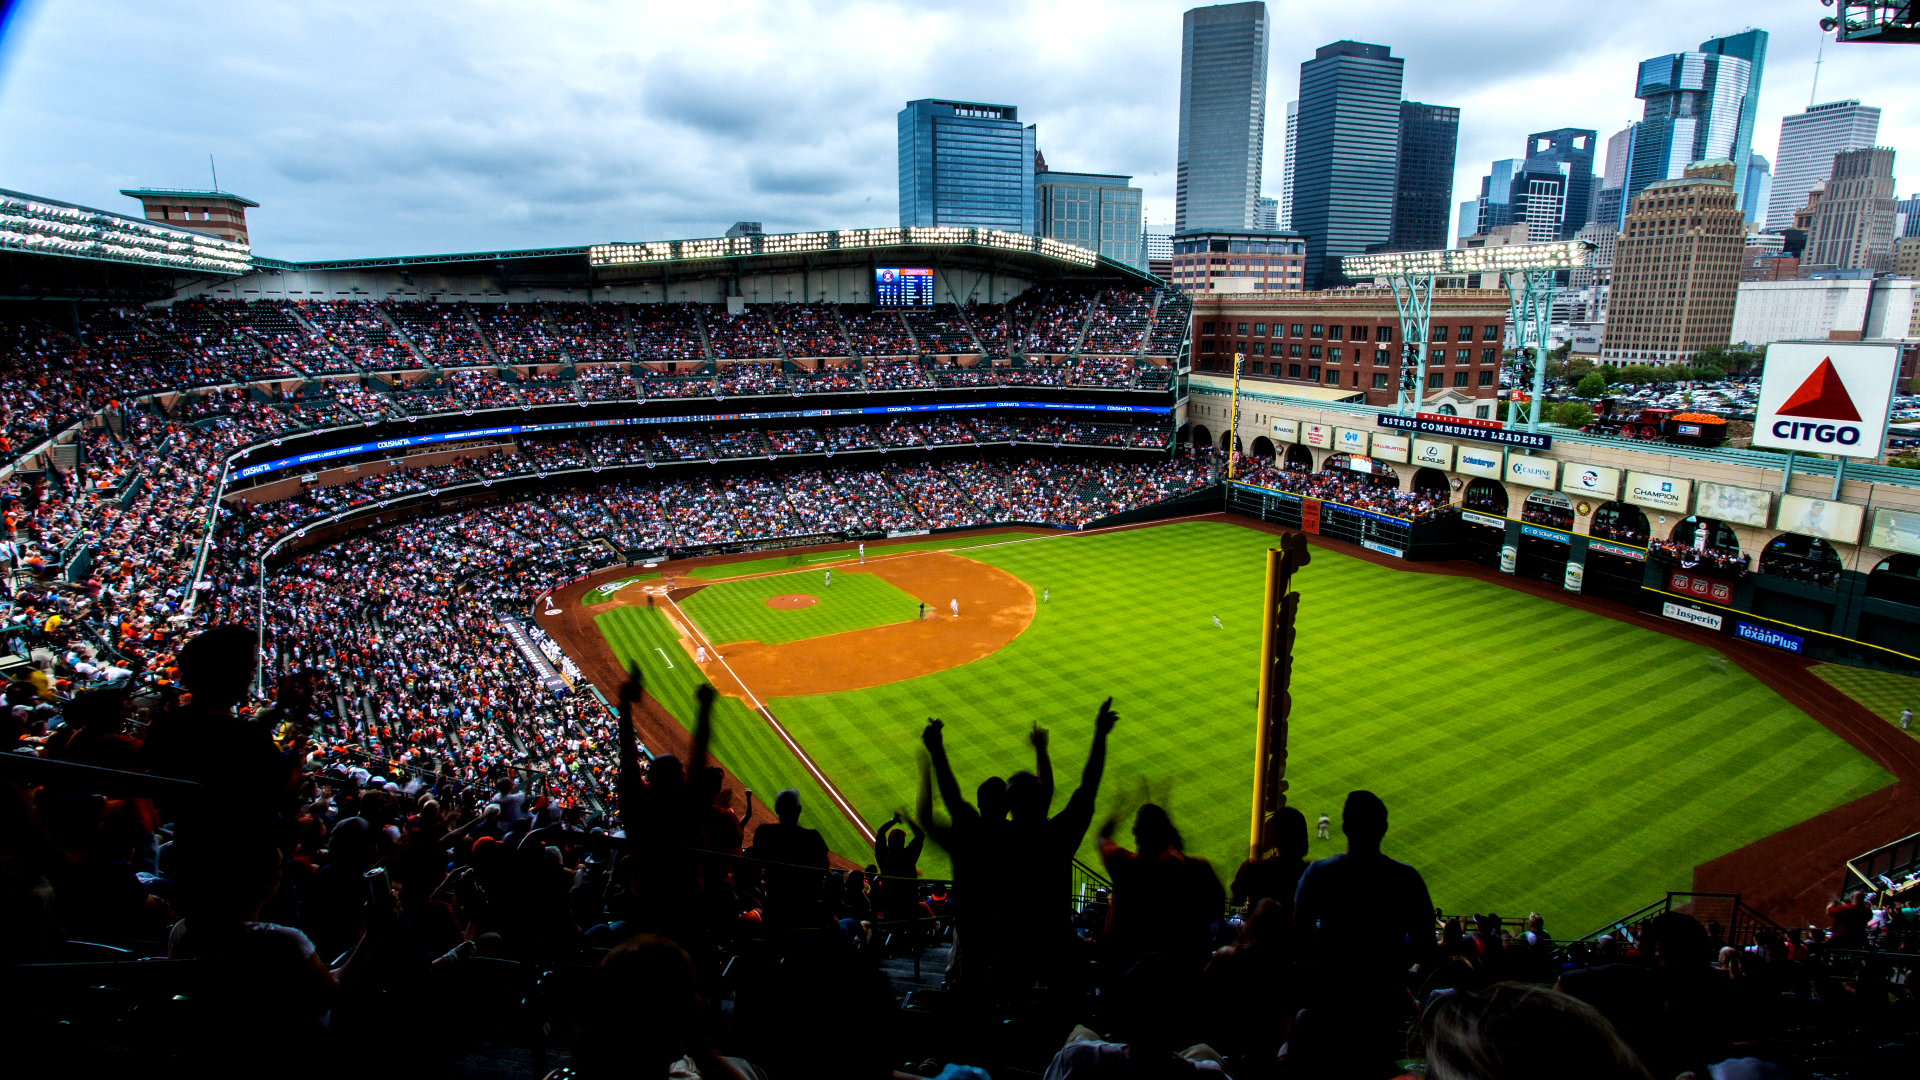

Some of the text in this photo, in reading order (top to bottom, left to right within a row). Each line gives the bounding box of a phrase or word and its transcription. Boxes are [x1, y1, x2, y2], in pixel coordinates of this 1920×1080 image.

[1383, 417, 1544, 446] ASTROS COMMUNITY LEADERS
[1772, 421, 1860, 445] CITGO
[377, 439, 410, 448] COUSHATTA
[1373, 443, 1406, 452] HALLIBURTON
[1418, 455, 1445, 464] LEXUS
[1462, 456, 1496, 468] Schlumberger
[243, 464, 270, 476] COUSHATTA
[1523, 467, 1550, 476] CALPINE
[1634, 488, 1679, 501] CHAMPION
[1653, 498, 1678, 506] SERVICES
[1377, 545, 1396, 555] mazda
[1676, 608, 1720, 628] Insperity
[1739, 625, 1798, 650] TexanPlus
